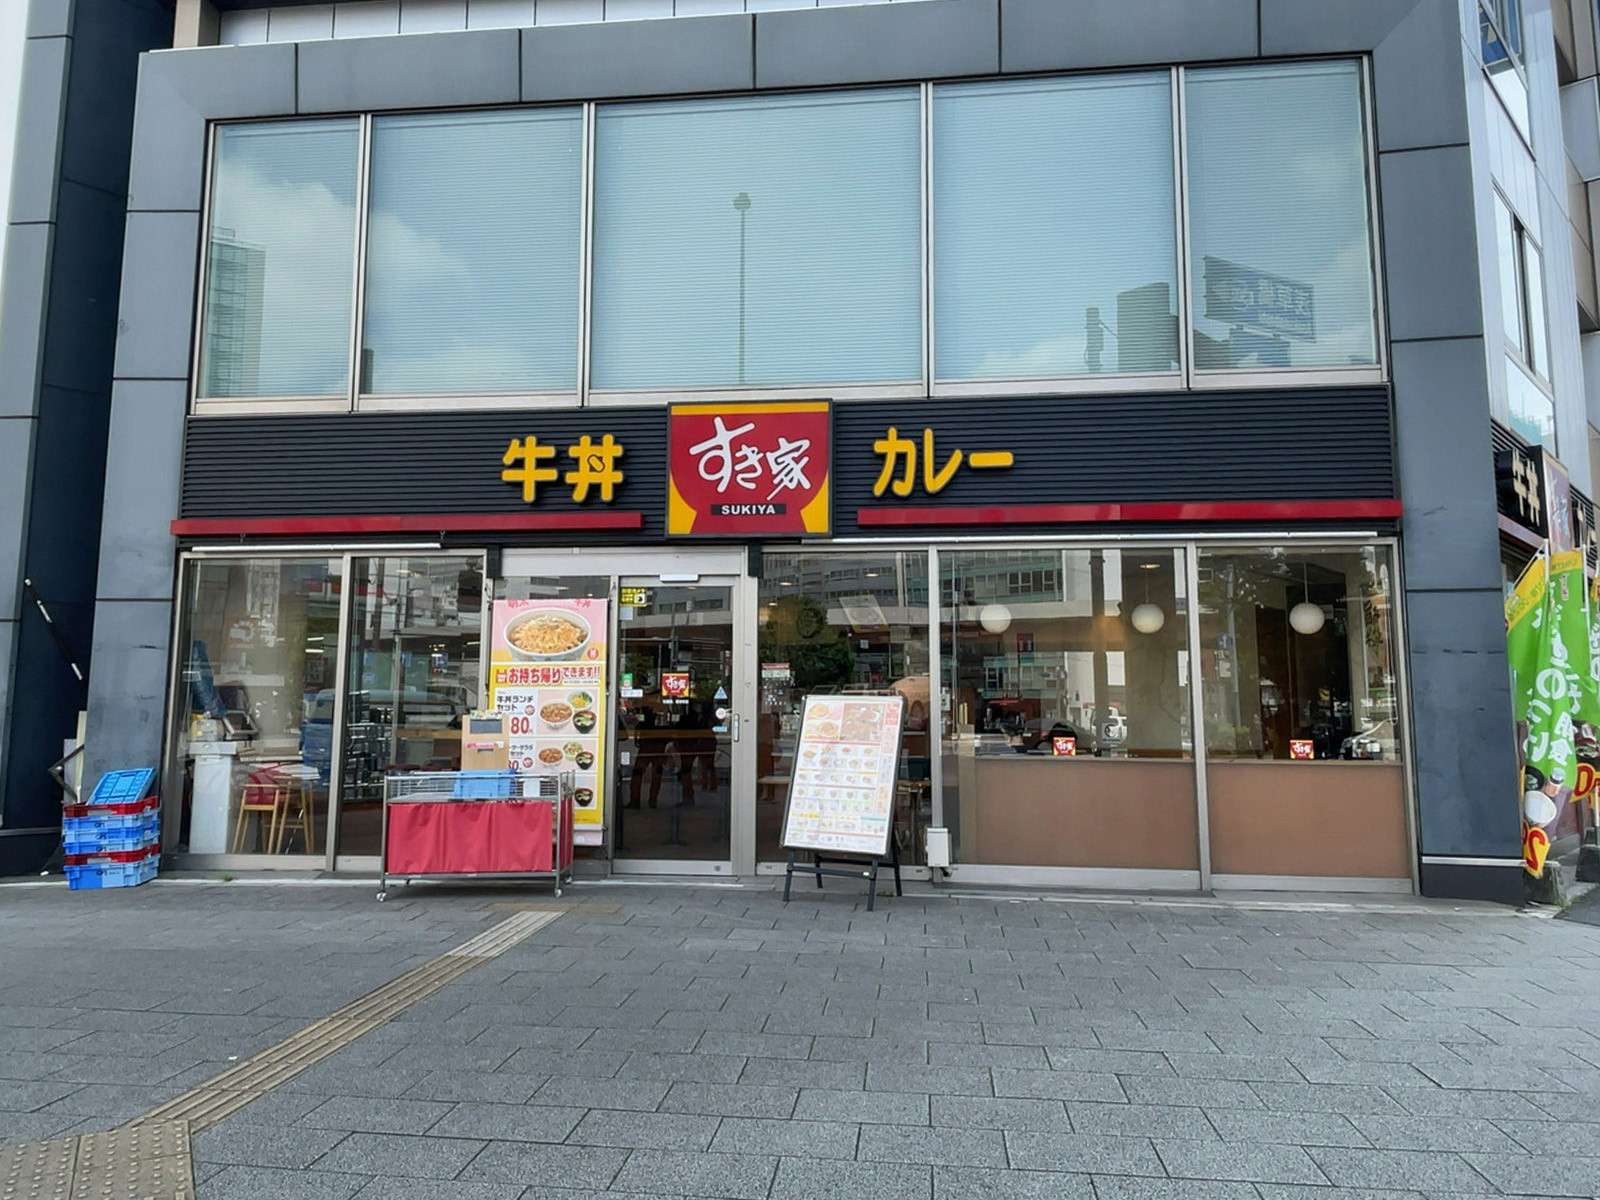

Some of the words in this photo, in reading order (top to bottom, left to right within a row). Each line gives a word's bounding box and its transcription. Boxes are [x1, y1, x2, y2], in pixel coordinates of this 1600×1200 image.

[502, 434, 623, 502] 牛丼
[689, 416, 811, 501] すき家
[873, 427, 1014, 496] カレー
[721, 505, 776, 515] SUKIYA
[497, 695, 534, 704] 牛丼ランチ
